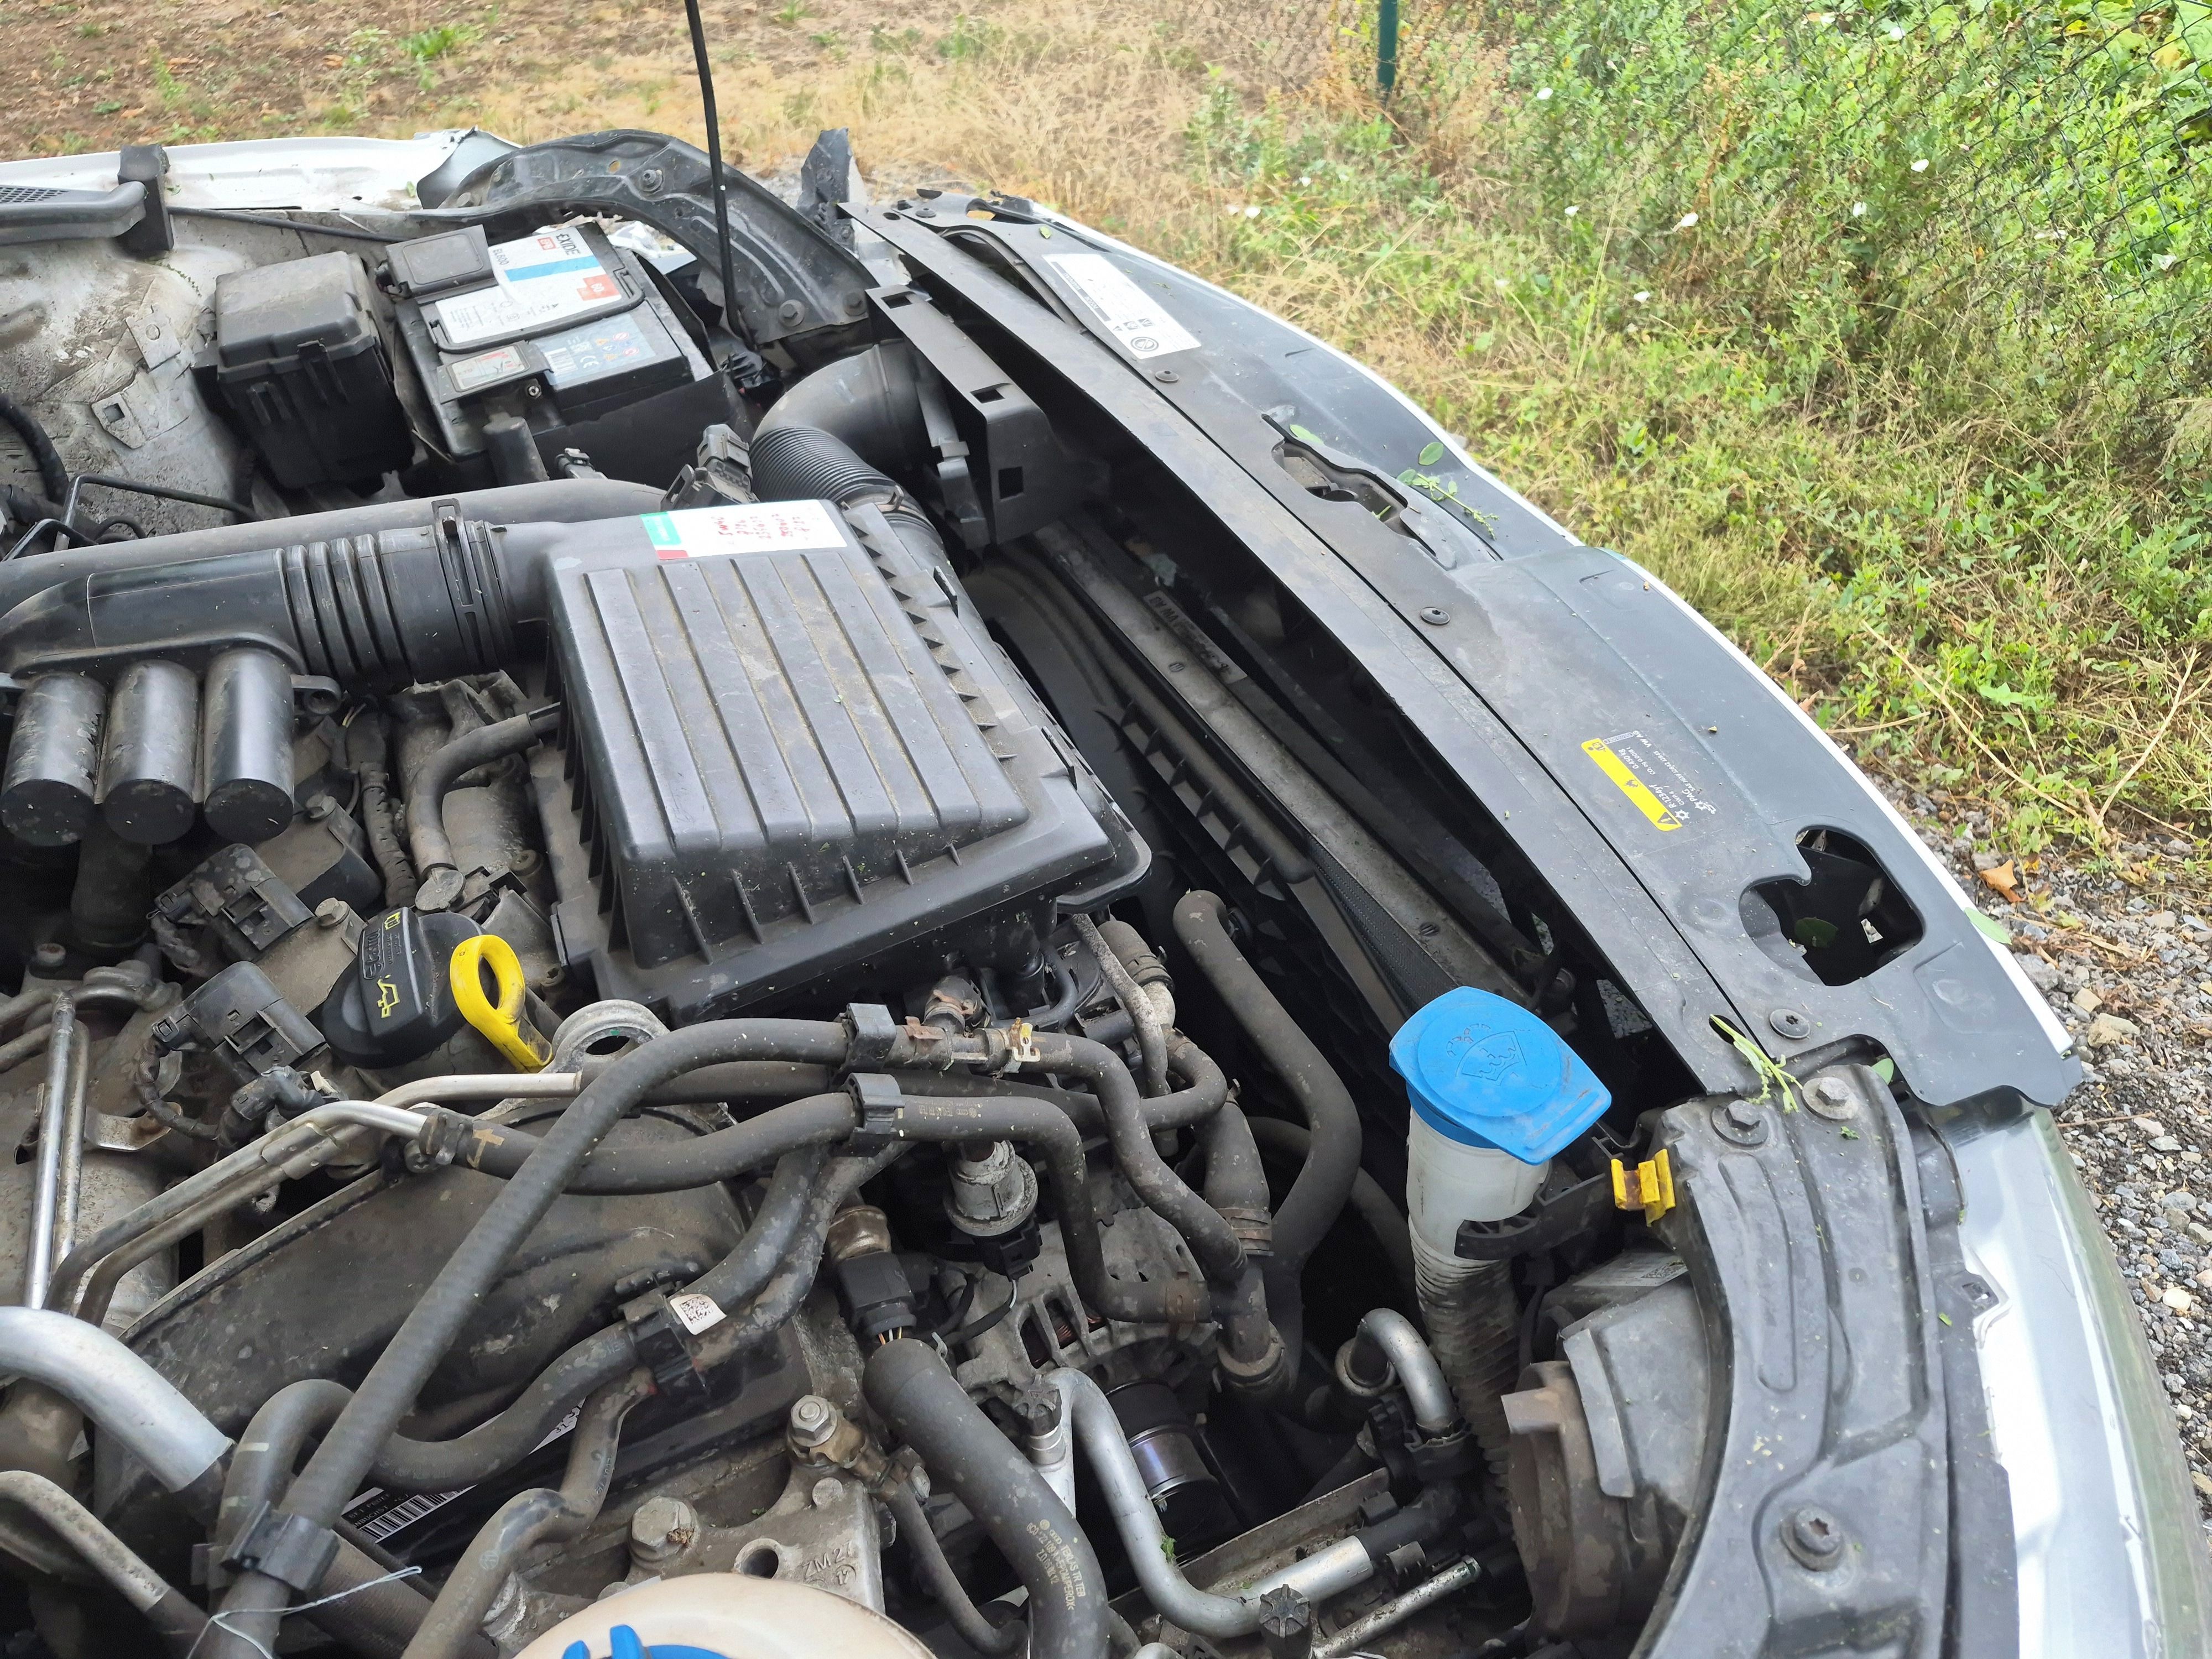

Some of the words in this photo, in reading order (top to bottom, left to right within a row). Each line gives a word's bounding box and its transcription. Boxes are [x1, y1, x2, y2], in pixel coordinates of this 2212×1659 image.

[555, 233, 581, 255] EXIDE
[1632, 730, 1644, 739] AG
[1640, 738, 1652, 748] VW
[1618, 748, 1626, 757] kg
[1623, 755, 1639, 769] 0.450
[1684, 781, 1695, 791] SAE
[1648, 784, 1677, 809] R-1234yf
[1672, 793, 1685, 805] GWP
[1682, 789, 1698, 802] PAG
[1060, 1545, 1079, 1572] TEKLAS
